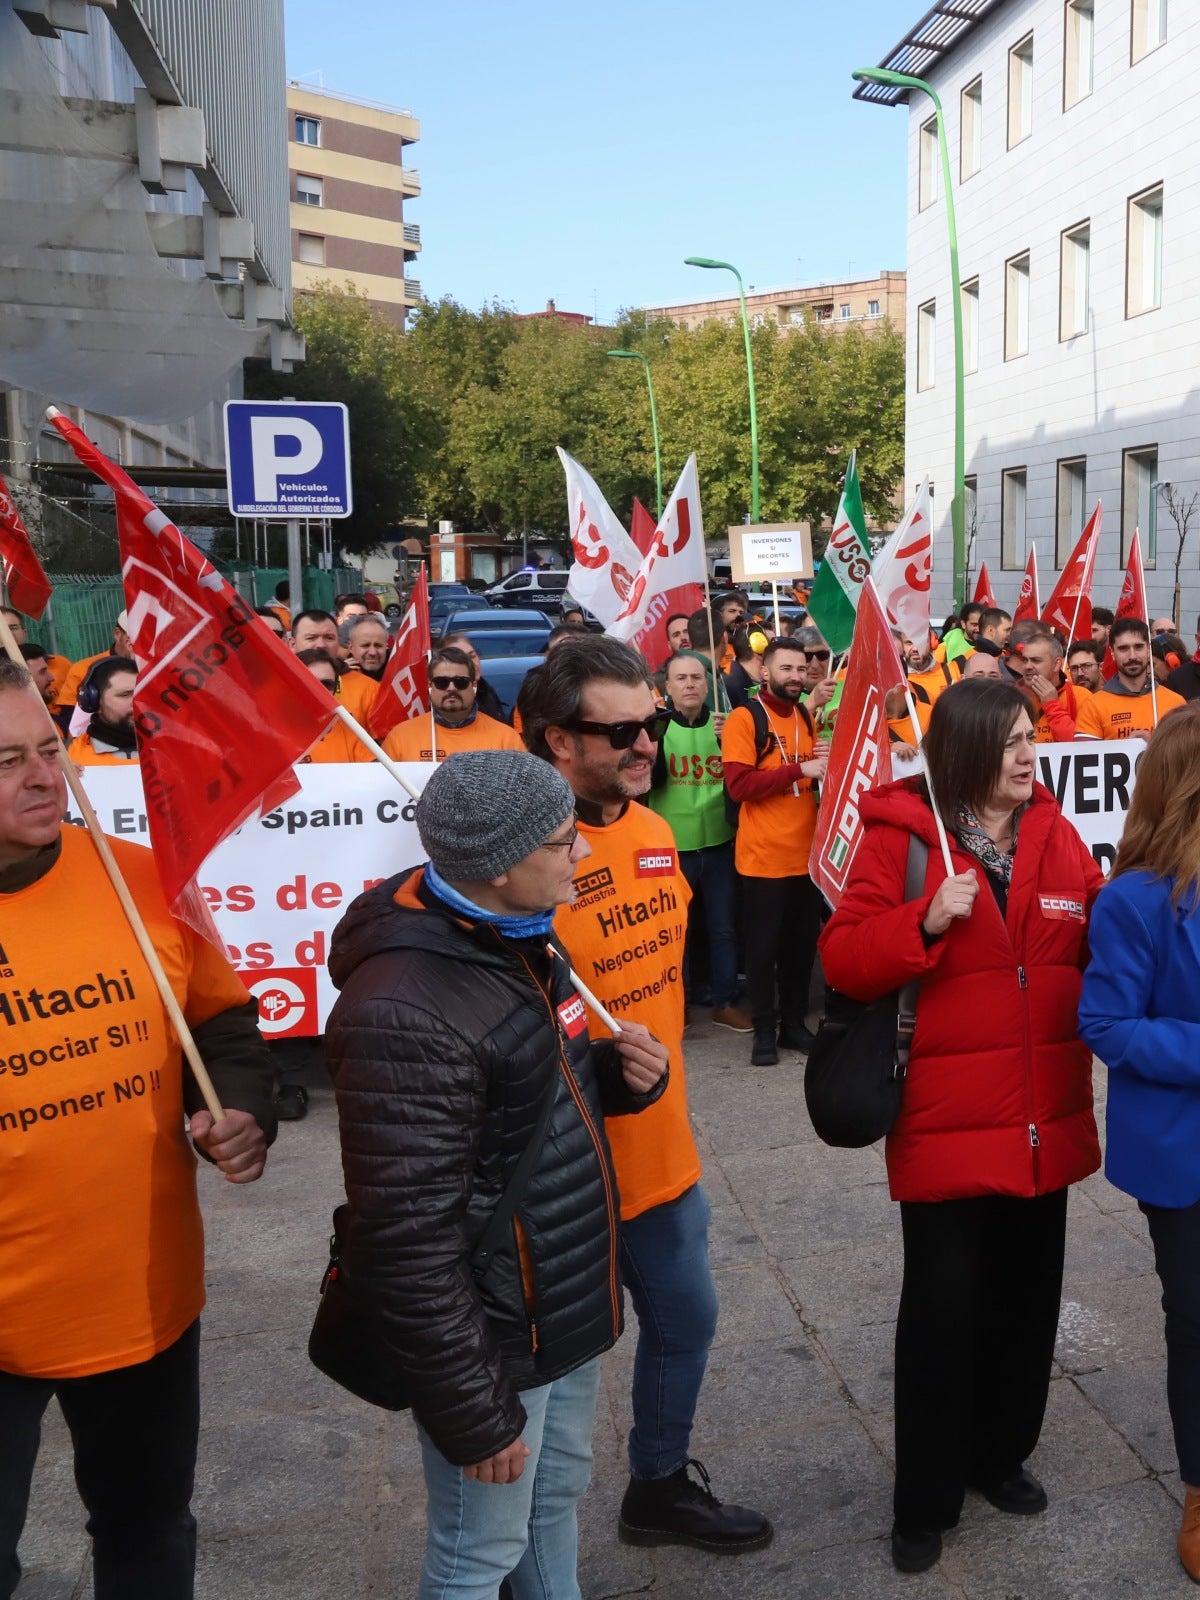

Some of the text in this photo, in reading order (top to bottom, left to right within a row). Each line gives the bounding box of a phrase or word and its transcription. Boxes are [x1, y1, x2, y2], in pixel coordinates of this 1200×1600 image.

[250, 416, 323, 502] P
[278, 505, 287, 513] DEL
[280, 494, 341, 503] Autorizados
[757, 552, 790, 560] RECORTES
[261, 803, 363, 835] Spain
[276, 875, 343, 911] de
[570, 886, 617, 912] industria
[597, 887, 677, 938] Hitachi
[107, 1024, 130, 1048] SI
[113, 1074, 146, 1103] NO
